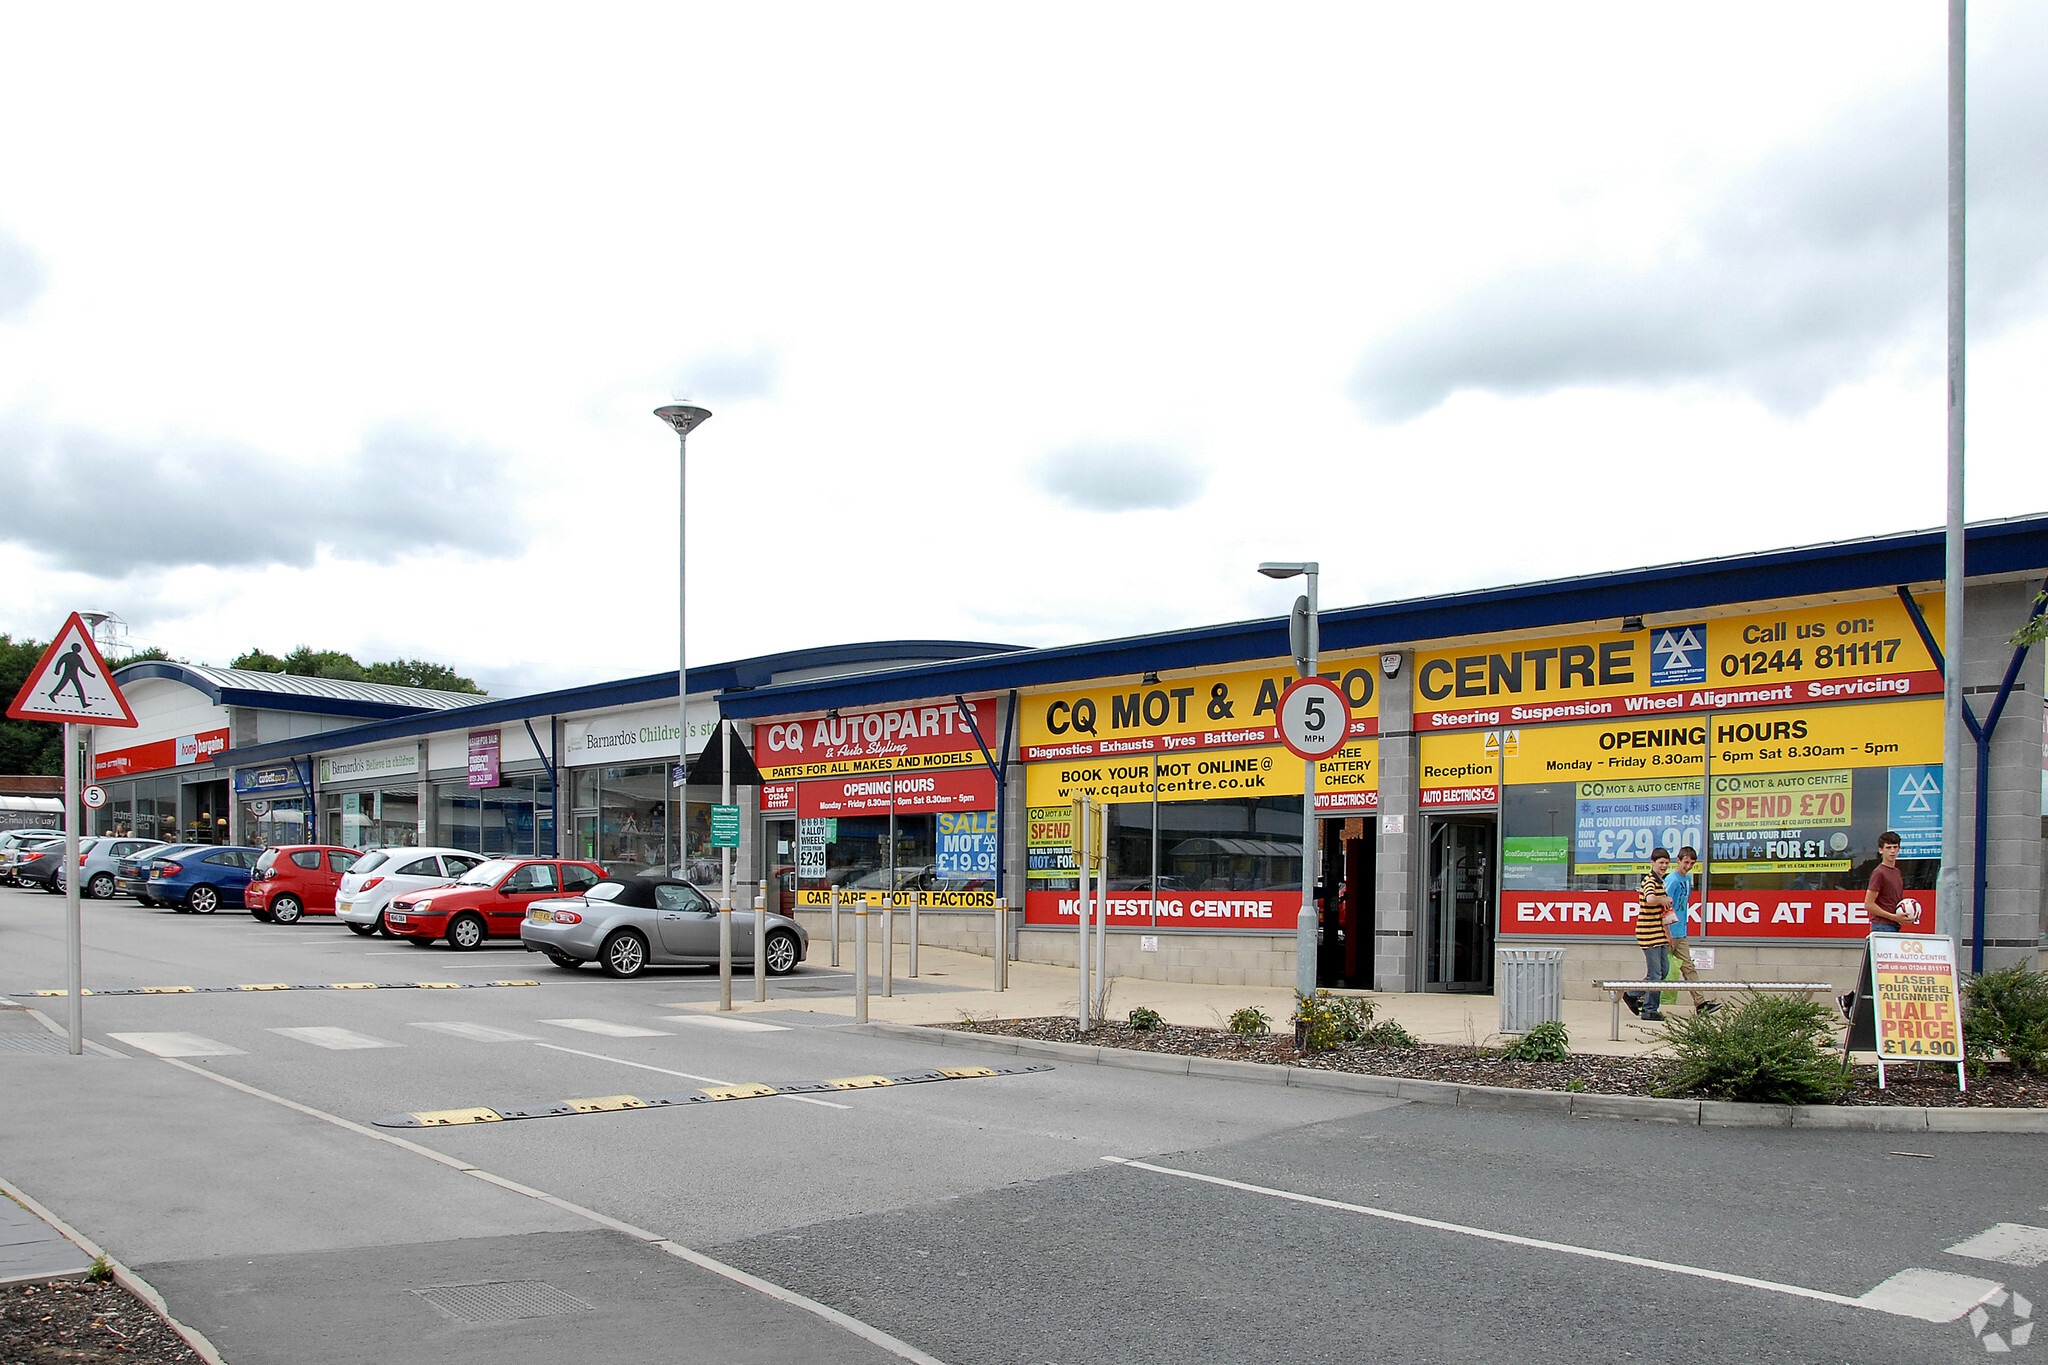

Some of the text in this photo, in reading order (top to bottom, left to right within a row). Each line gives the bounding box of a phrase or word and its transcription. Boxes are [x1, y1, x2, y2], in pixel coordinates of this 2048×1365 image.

[1743, 617, 1874, 645] Call us on:
[1720, 638, 1901, 678] 01244 811117
[1419, 639, 1634, 701] CENTRE
[1047, 668, 1374, 738] CQ MOT & AO
[1432, 678, 1911, 727] Steering Suspension Wheel Alignment Servicing
[1304, 697, 1326, 732] 5
[587, 730, 636, 749] Barnardo's
[639, 721, 696, 744] Childre's
[701, 720, 718, 736] sto
[768, 703, 978, 754] CQ AUTOPARTS
[1598, 719, 1808, 750] OPENING HOURS
[1028, 744, 1093, 760] Diagnostics
[1099, 739, 1154, 753] Exhausts
[1162, 735, 1196, 750] Tyres
[1204, 729, 1264, 745] Batteries
[1305, 735, 1325, 743] MPH
[182, 743, 197, 756] home
[826, 739, 908, 758] & Auto Styling
[1546, 742, 1899, 772] Monday Friday 8.30am 6pm Sat 8.30am 5pm
[773, 752, 973, 778] PARTS FOR ALL MAKES AND MODELS
[1061, 757, 1273, 783] BOOK YOUR MOT ONLINE @
[1320, 760, 1372, 774] BATTERY
[1424, 763, 1492, 778] Reception
[843, 777, 935, 797] OPENING HOURS
[1325, 774, 1366, 786] CHECK
[1716, 774, 1848, 792] CQ MOT & AUTO CENTRE
[90, 790, 99, 801] 5
[1422, 787, 1481, 804] AUTO ELECTRICS
[1581, 781, 1701, 798] CQ MOT & AUTO CENTRE
[819, 793, 975, 810] Monday Friday 8.30am 6pm Sat 8.30am 5pm
[1331, 793, 1366, 806] ELECTRICS
[1596, 805, 1612, 813] STAY
[1634, 804, 1649, 812] THIS
[1651, 803, 1682, 811] SUMMER
[1716, 792, 1845, 820] SPEND £70
[1045, 810, 1059, 818] MOT
[1579, 814, 1701, 828] AIR CONDITIONING RE-GAS
[801, 826, 825, 836] 4 ALLOY
[939, 813, 996, 835] SALE
[1031, 822, 1070, 840] SPEND
[801, 836, 826, 845] WHEELS
[1579, 830, 1595, 839] NOW
[1712, 829, 1802, 841] WE WILL DO YOUR NEXT
[944, 834, 983, 853] MOT
[1578, 839, 1597, 848] ONLY
[1597, 827, 1701, 860] £2990
[1712, 842, 1750, 860] MOT
[1765, 840, 1802, 859] FOR
[801, 851, 824, 866] £249
[1029, 855, 1049, 869] MOT
[807, 892, 830, 904] CAR
[933, 892, 994, 906] FACTORS
[1058, 900, 1273, 918] MOT TESTING CENTRE
[1517, 902, 1812, 924] EXTRA PKING AT
[1900, 941, 1923, 954] CQ
[1894, 974, 1935, 985] LASER
[1879, 984, 1952, 994] FOUR WHEEL
[1882, 993, 1949, 1002] ALIGNMENT
[1885, 1001, 1948, 1021] HALF
[1881, 1019, 1954, 1039] PRICE
[1884, 1039, 1955, 1056] £14.90
